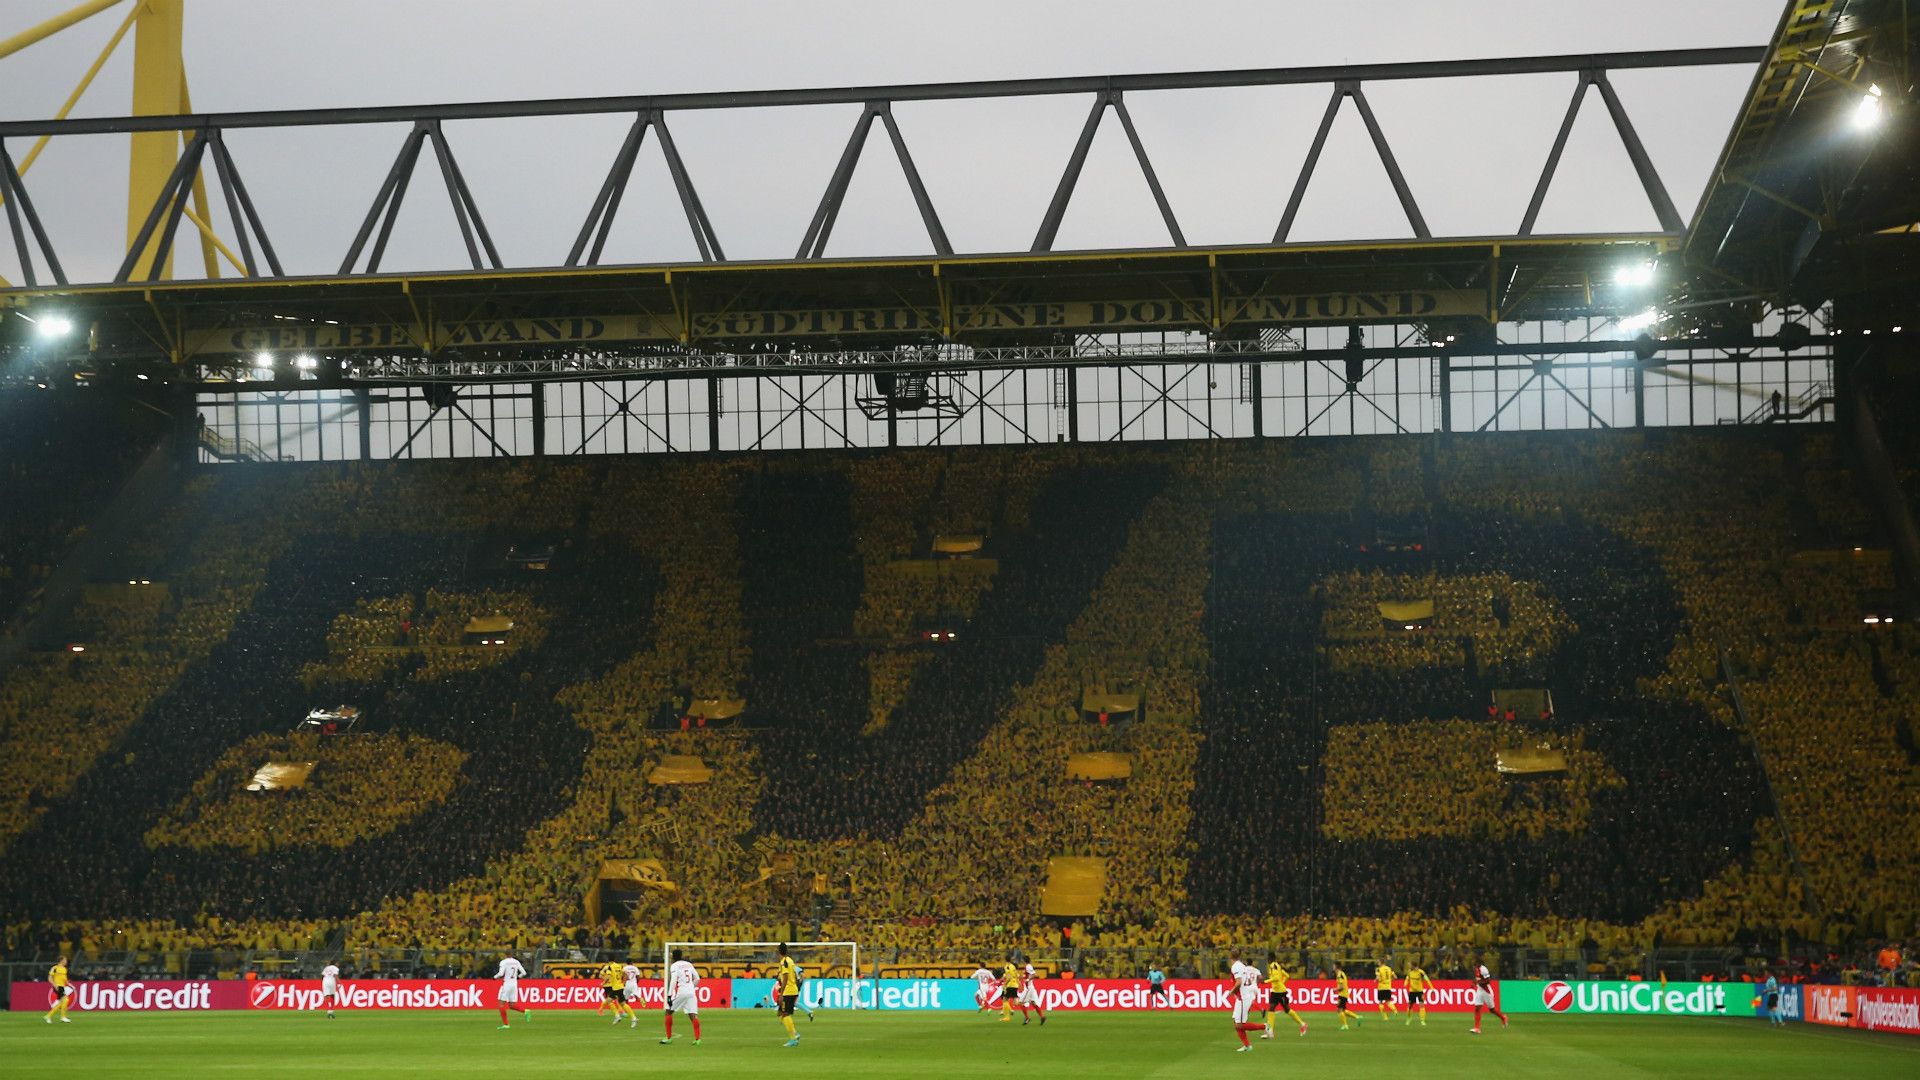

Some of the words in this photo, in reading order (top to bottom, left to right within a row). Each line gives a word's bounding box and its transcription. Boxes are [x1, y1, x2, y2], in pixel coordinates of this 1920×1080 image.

[231, 324, 410, 351] GELBE
[443, 316, 606, 344] WAND
[694, 303, 1065, 335] SÜDTRIBÜNE
[1089, 292, 1437, 324] DORTMUND
[78, 982, 211, 1010] UniCredit
[803, 981, 941, 1008] UniCredit
[1034, 983, 1232, 1011] ypoVereinsbank
[1577, 983, 1727, 1014] UniCredit
